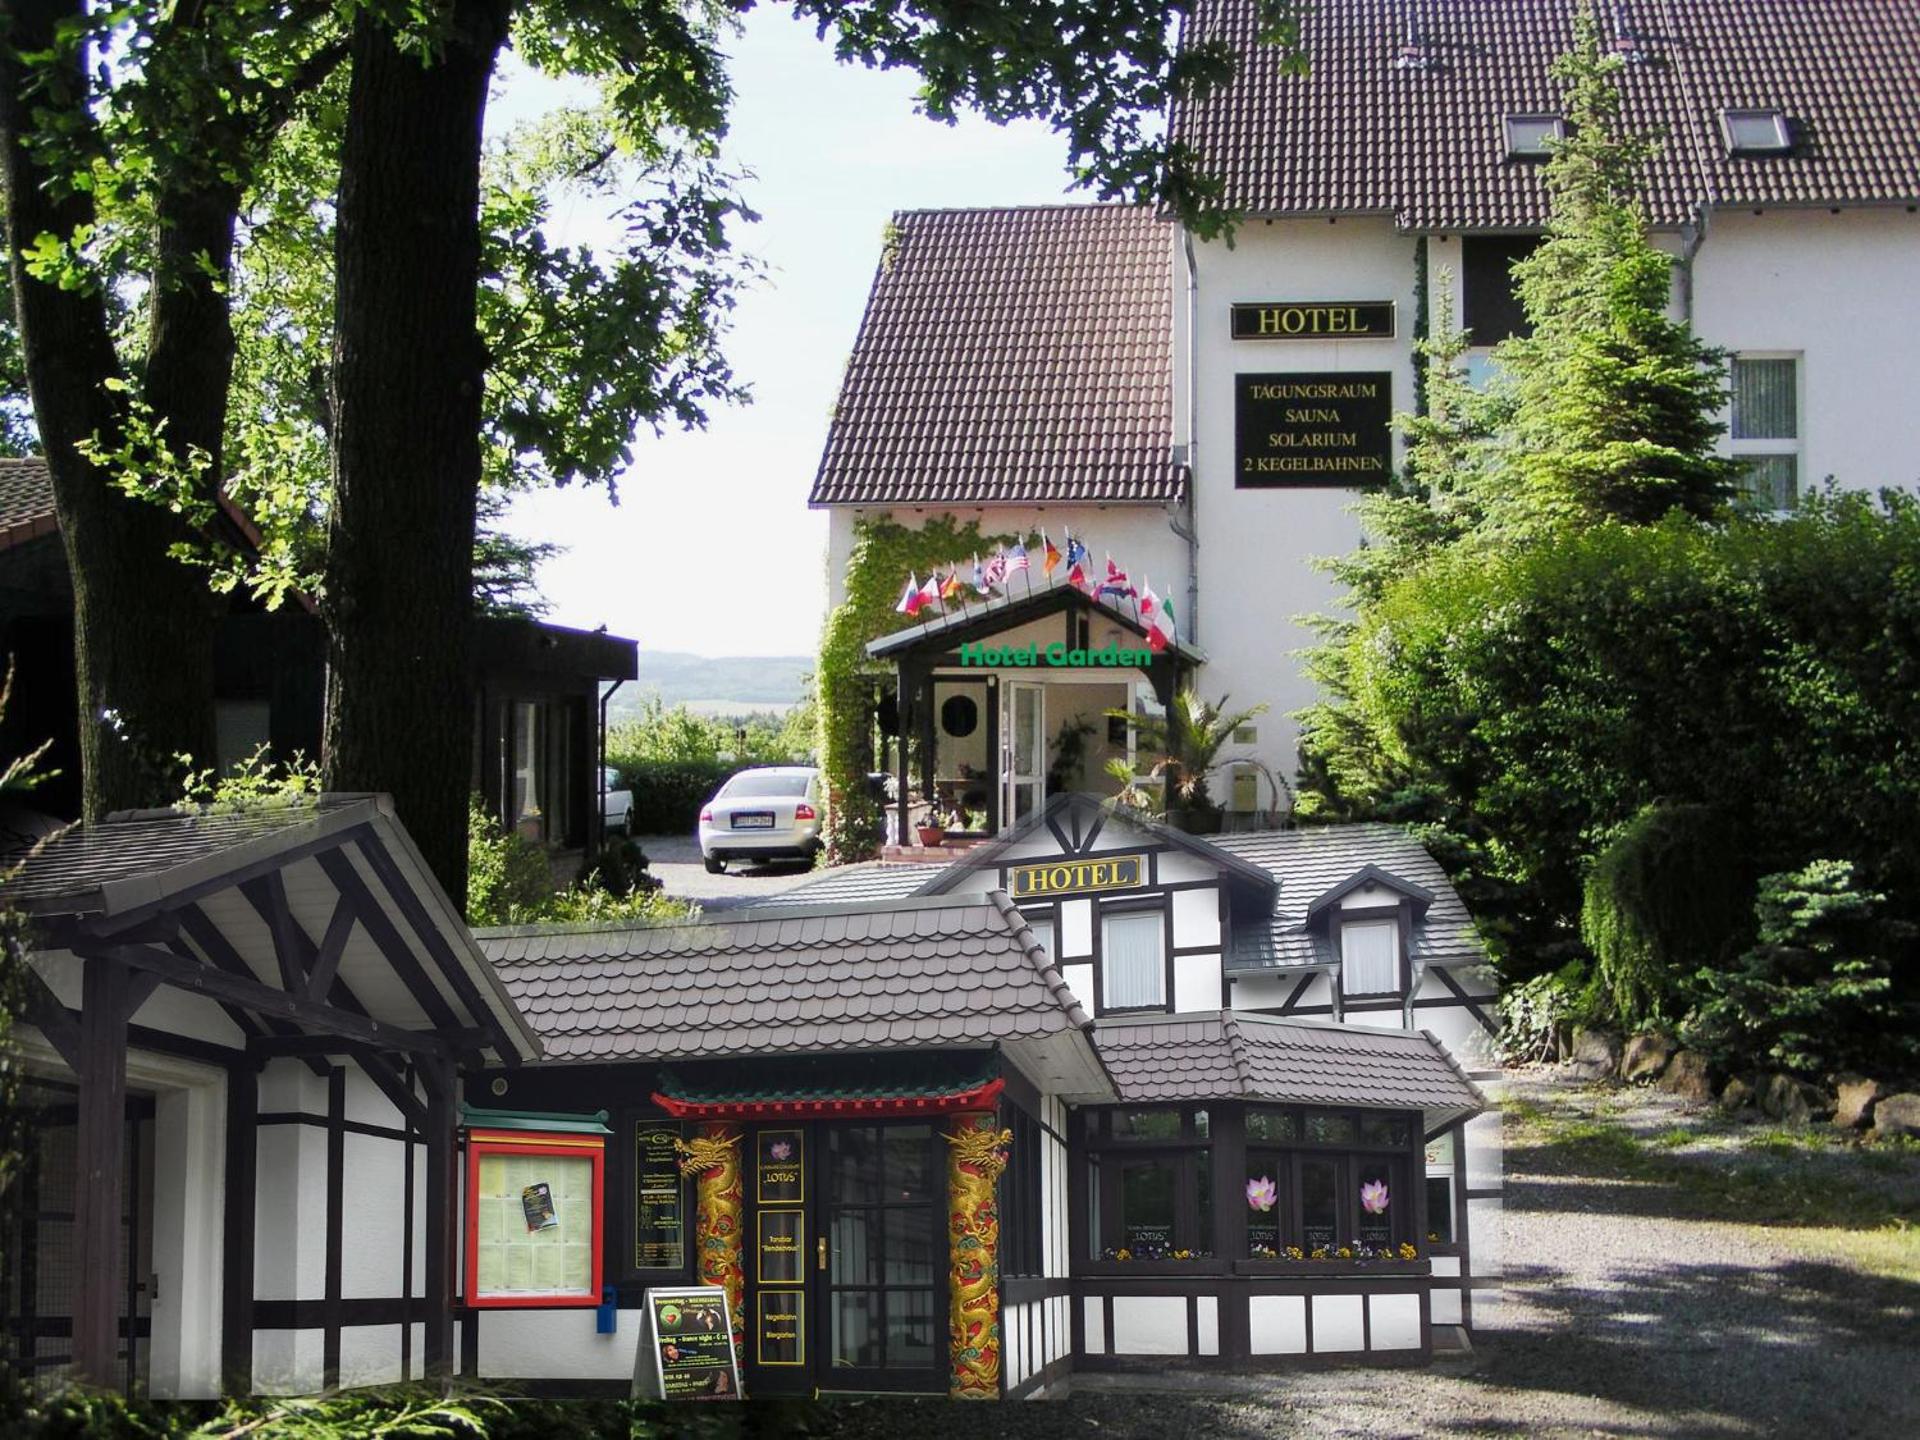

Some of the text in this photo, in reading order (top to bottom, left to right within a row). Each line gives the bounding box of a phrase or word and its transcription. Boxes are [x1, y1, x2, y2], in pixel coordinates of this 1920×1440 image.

[1259, 308, 1368, 333] HOTEL
[1250, 384, 1376, 399] TAGUNGSRAUM
[1285, 409, 1340, 423] SAUNA
[1269, 433, 1356, 447] SOLARIUM
[1244, 457, 1383, 471] 2 KEGELBAHNEN
[961, 641, 1152, 666] Hotel Garden
[1027, 863, 1128, 892] HOTEL
